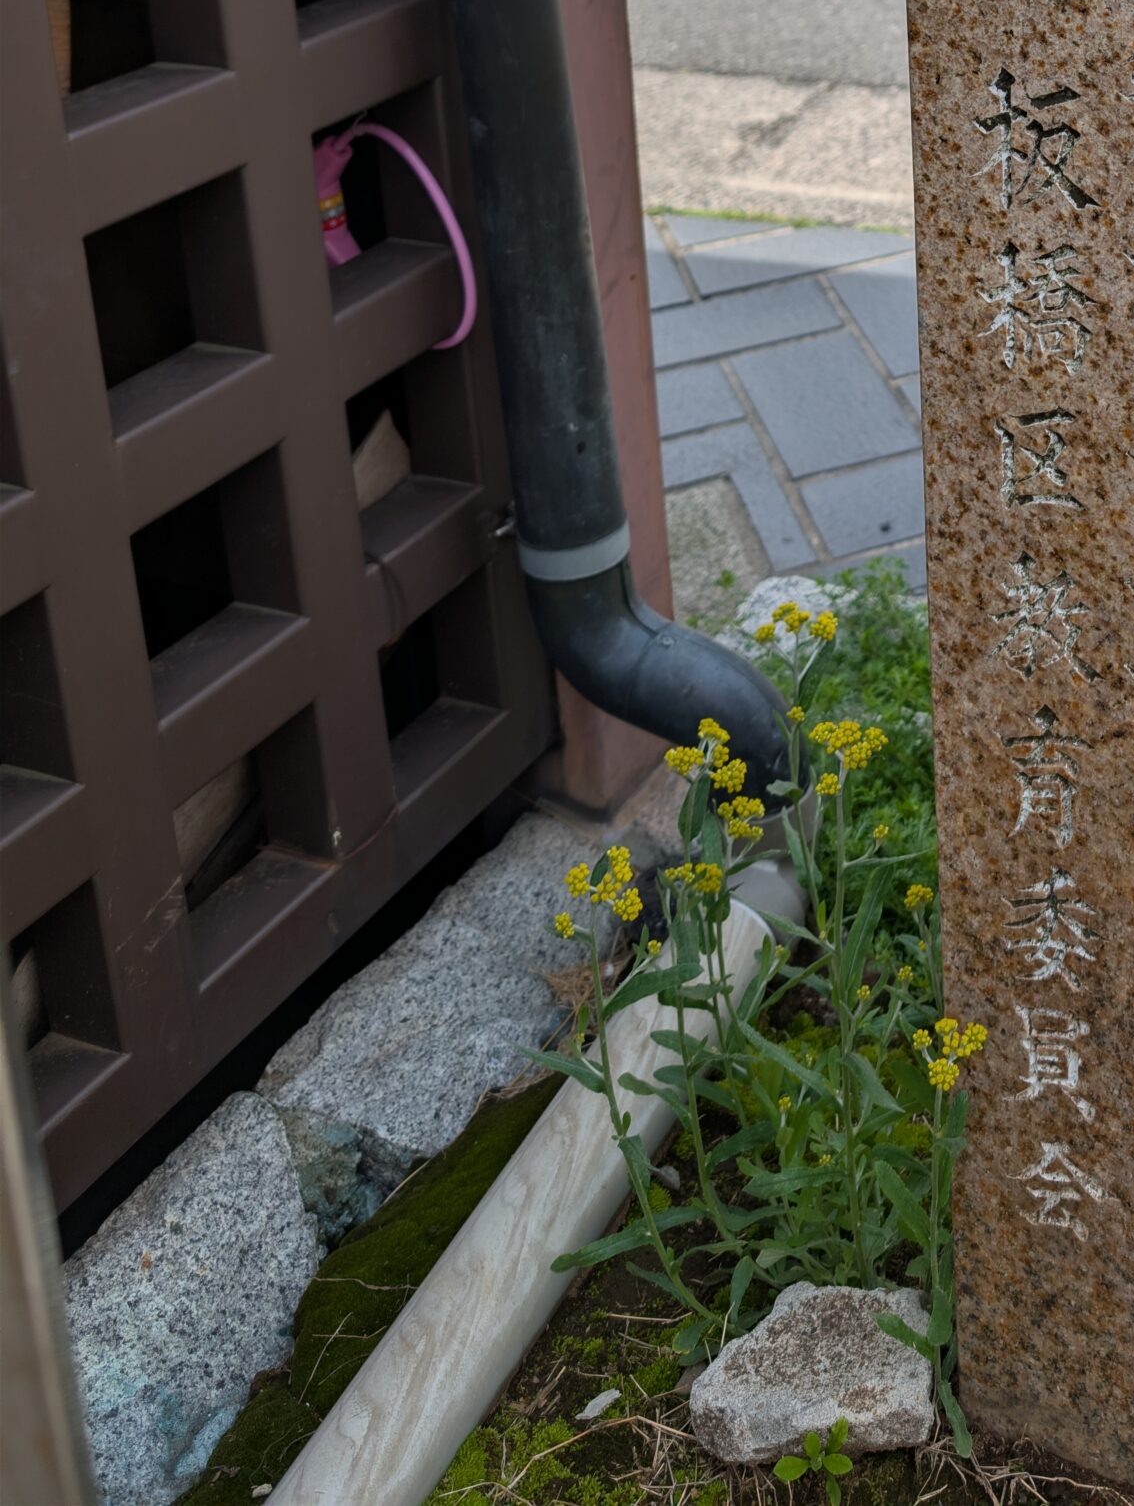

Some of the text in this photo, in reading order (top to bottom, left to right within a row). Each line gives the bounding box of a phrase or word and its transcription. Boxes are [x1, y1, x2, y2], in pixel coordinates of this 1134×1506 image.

[968, 67, 1106, 1242] 板橋区教育委員会
